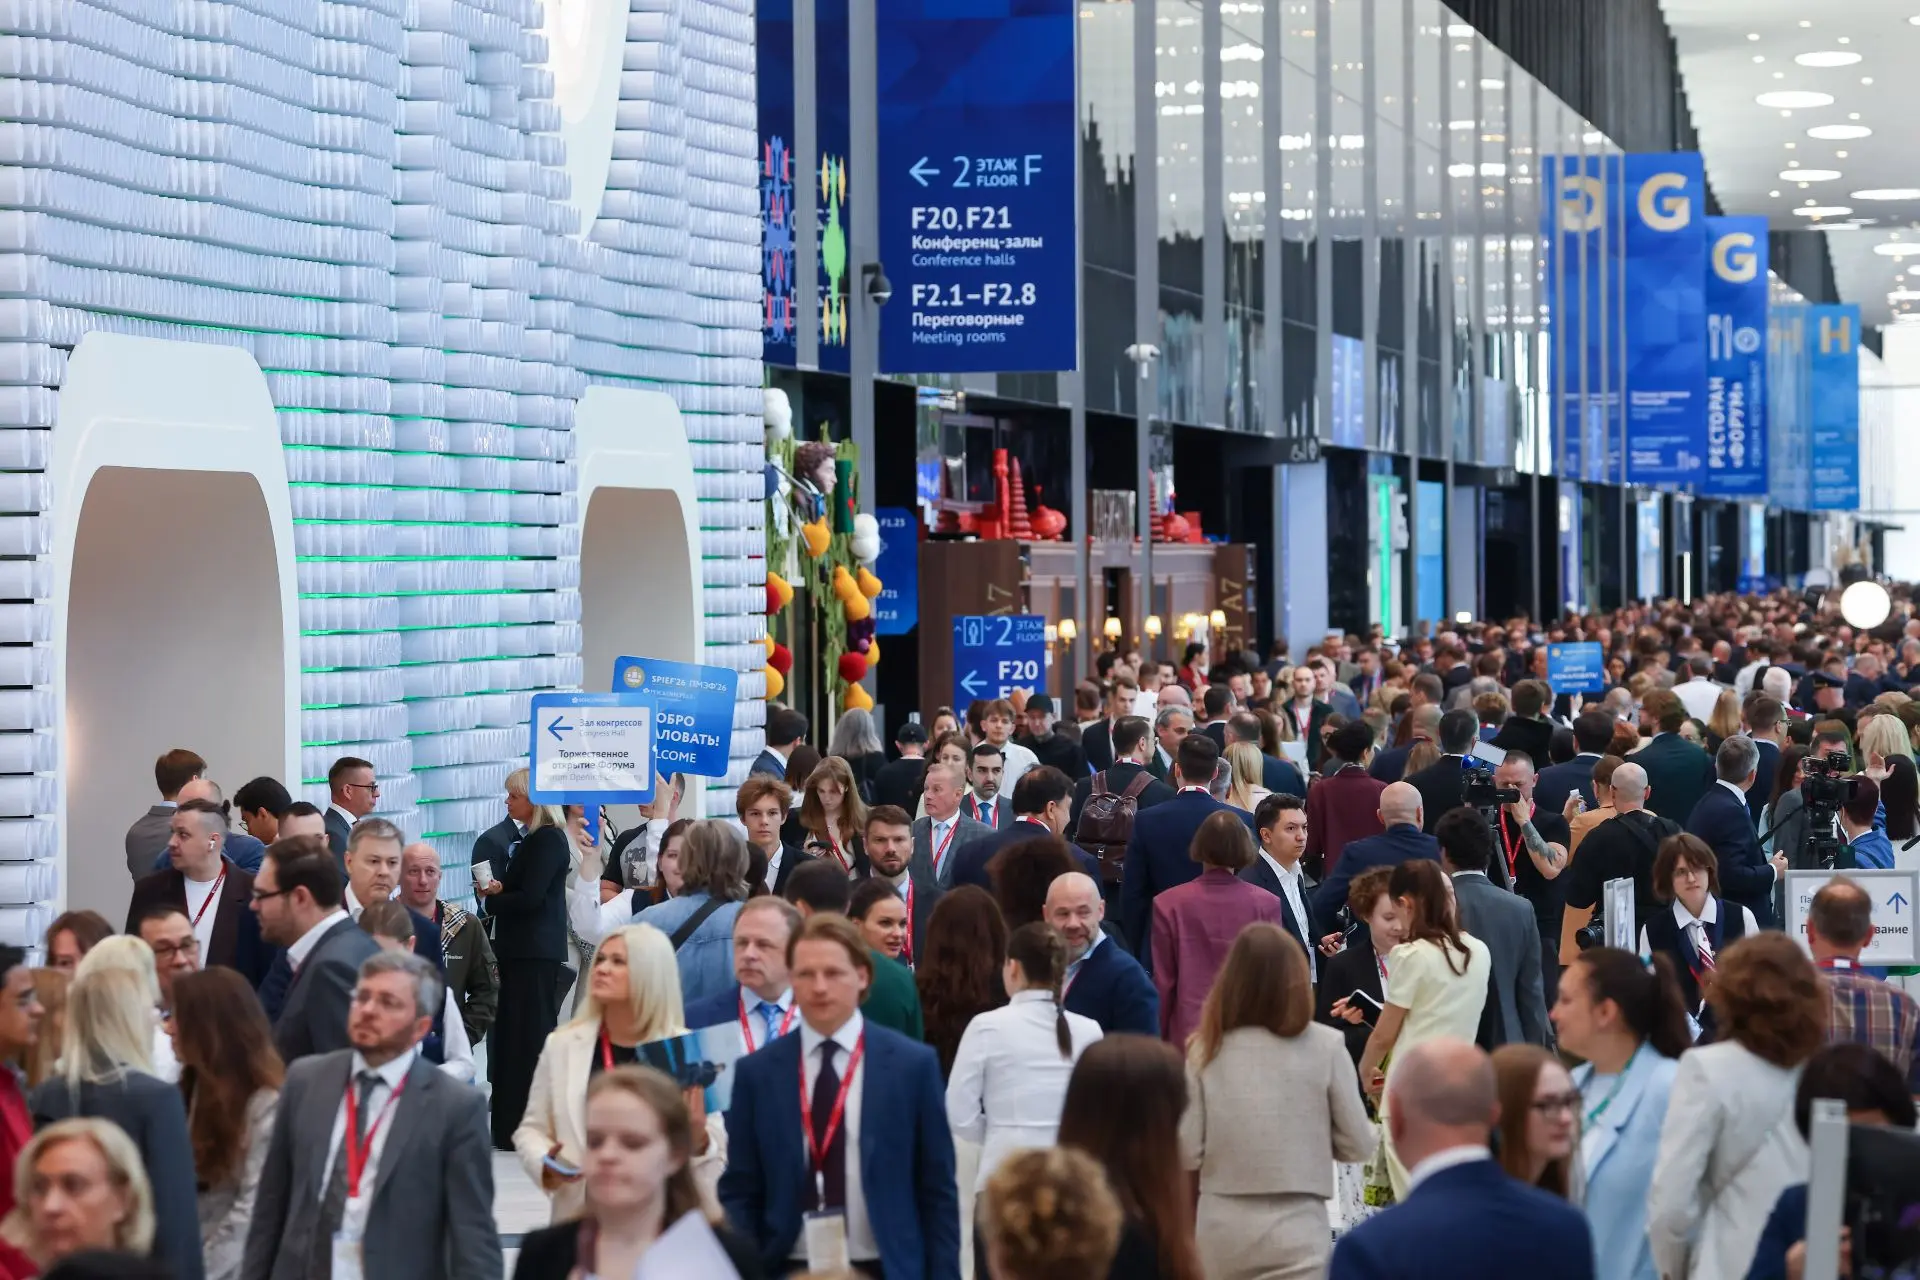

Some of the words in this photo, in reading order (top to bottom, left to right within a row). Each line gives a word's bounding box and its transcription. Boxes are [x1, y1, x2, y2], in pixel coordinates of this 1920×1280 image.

[953, 156, 970, 187] 2
[976, 158, 1018, 172] ЭТАЖ
[1025, 155, 1043, 185] F
[976, 174, 1018, 187] FLOOR
[1637, 173, 1690, 232] G
[911, 235, 1043, 252] Конференц-залы
[912, 252, 982, 267] Conference
[985, 253, 1016, 266] halls
[1713, 233, 1758, 283] G
[911, 311, 1025, 330] Переговорные
[912, 331, 963, 346] Meeting
[966, 332, 1006, 343] rooms
[1820, 316, 1851, 354] H
[1708, 377, 1726, 468] РЕСТОРАН
[996, 616, 1013, 646] 2
[998, 660, 1039, 681] F20
[596, 720, 643, 729] конгрессов
[656, 712, 695, 727] ОБРО
[558, 749, 630, 760] Торжественное
[656, 749, 697, 763] LCOME
